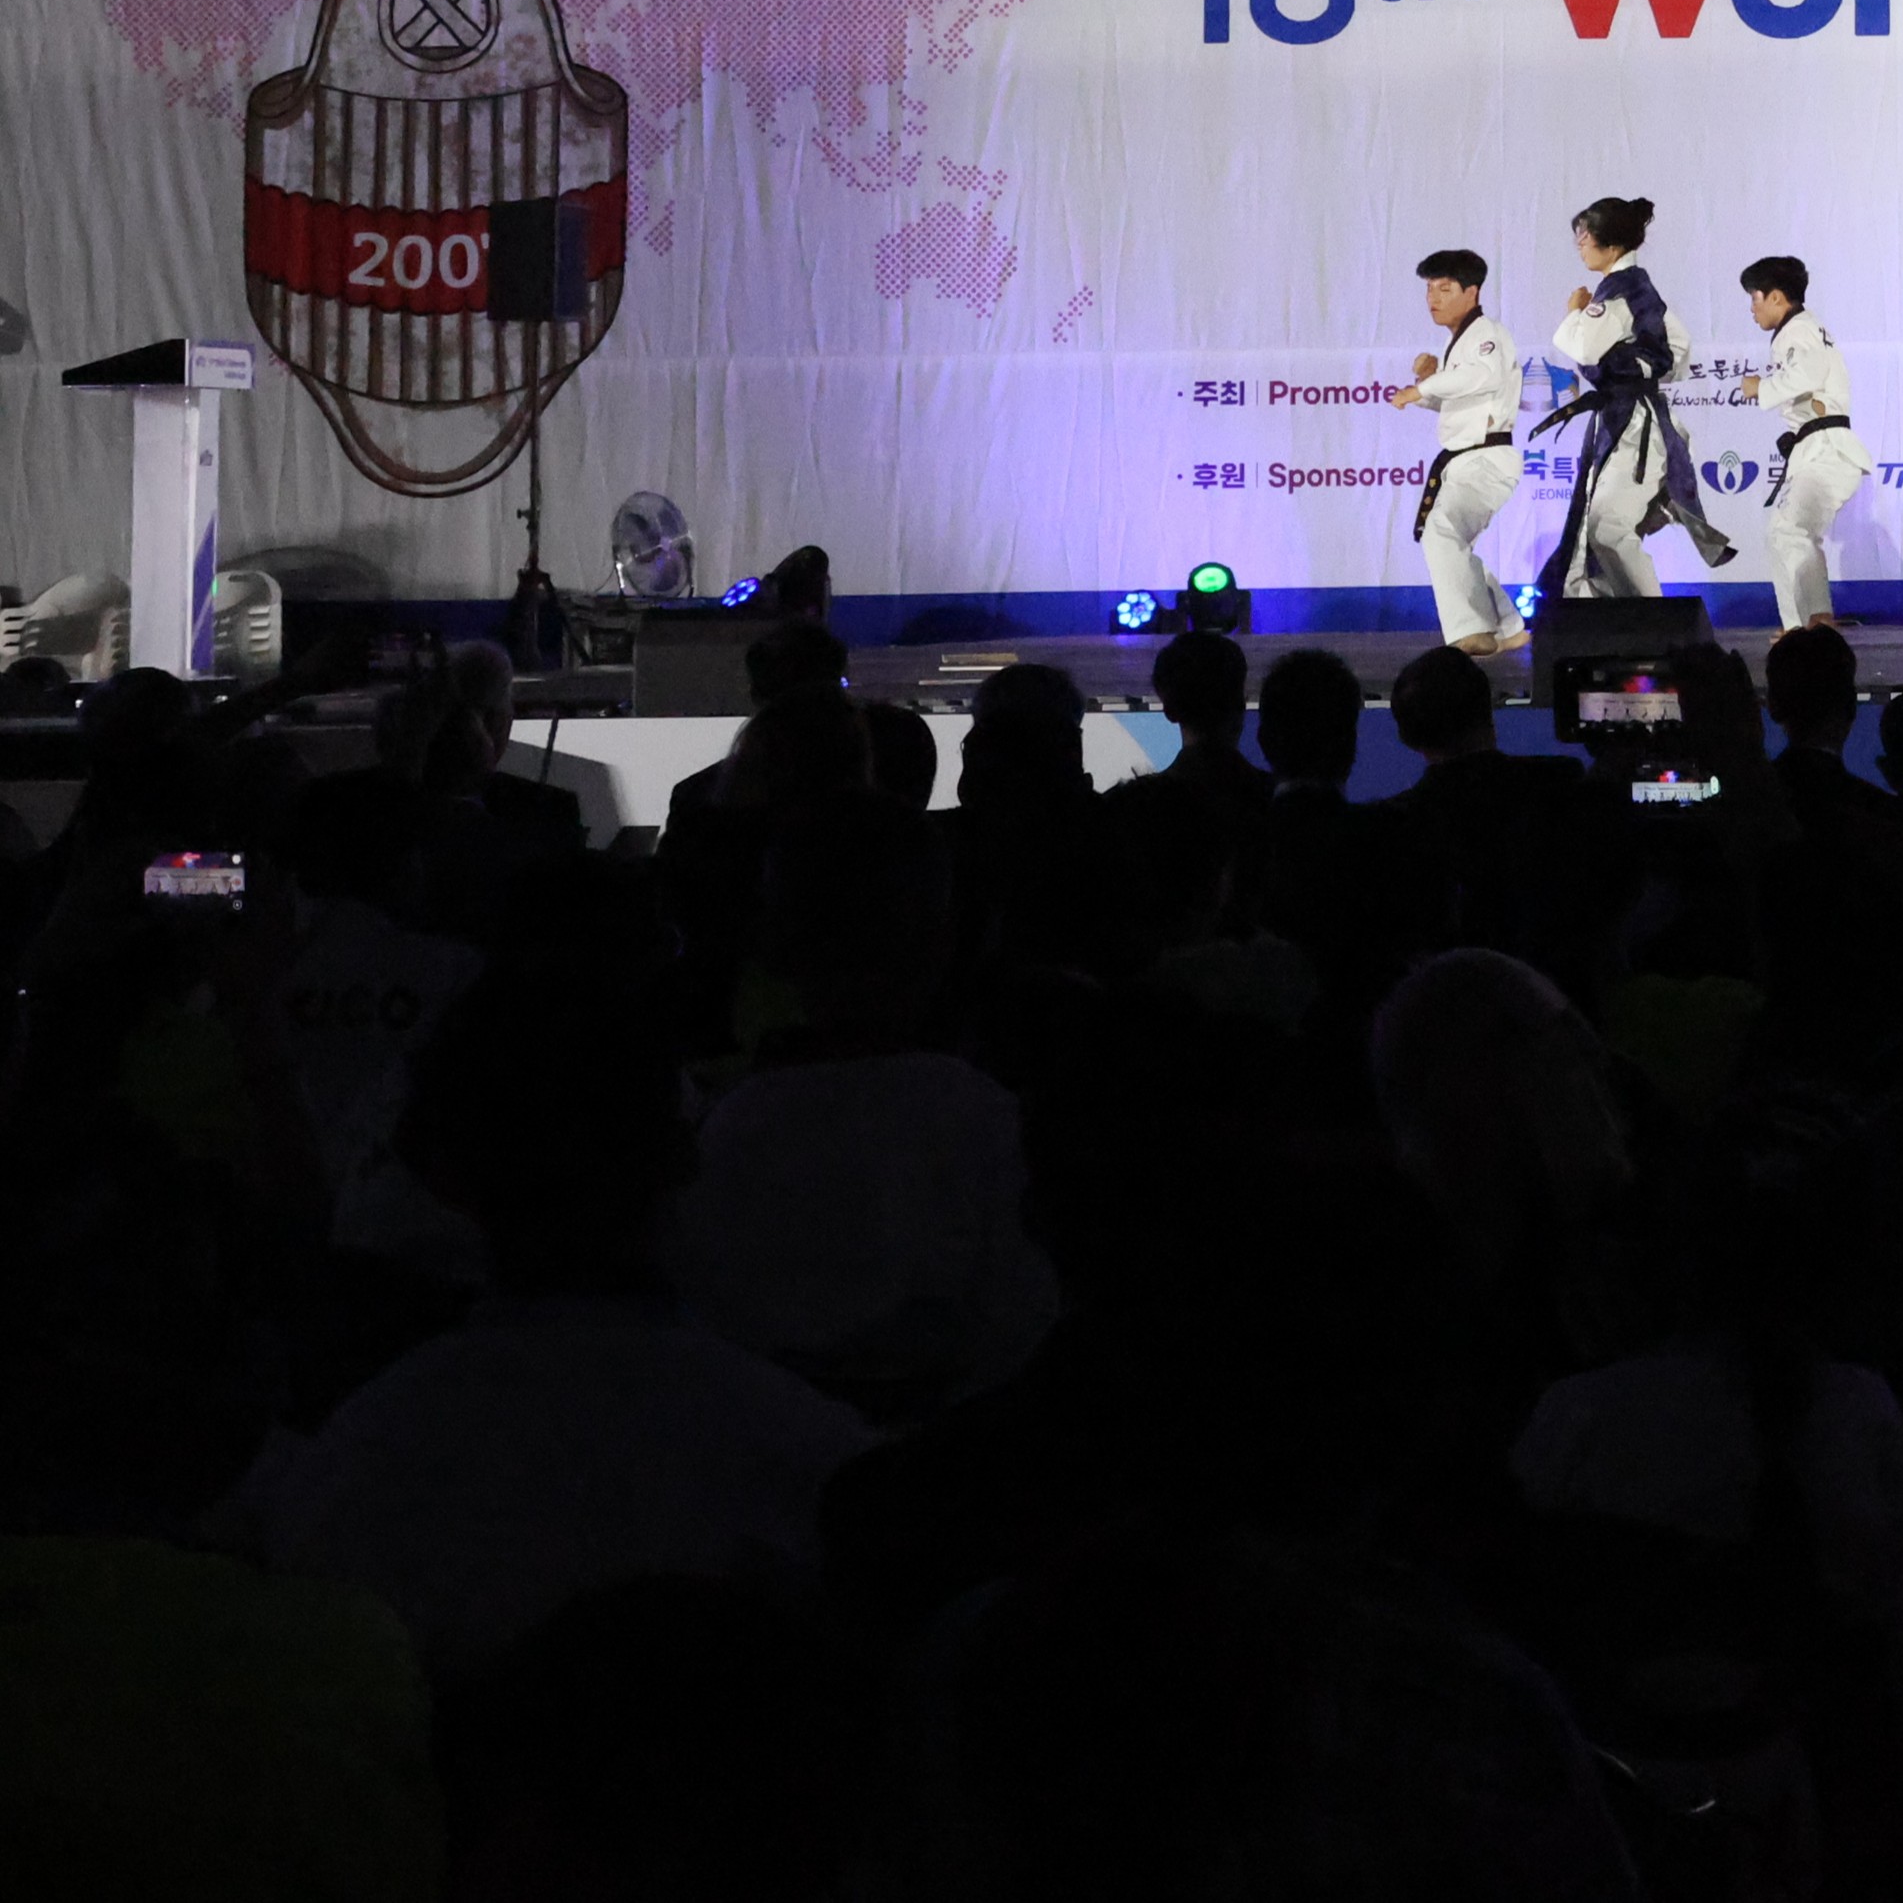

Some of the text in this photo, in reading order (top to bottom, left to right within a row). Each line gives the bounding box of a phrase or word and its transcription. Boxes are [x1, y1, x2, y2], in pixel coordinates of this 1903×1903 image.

[348, 230, 490, 290] 200
[1193, 380, 1245, 408] 주최
[1193, 462, 1245, 490] 후원
[1268, 459, 1424, 494] Sponsored
